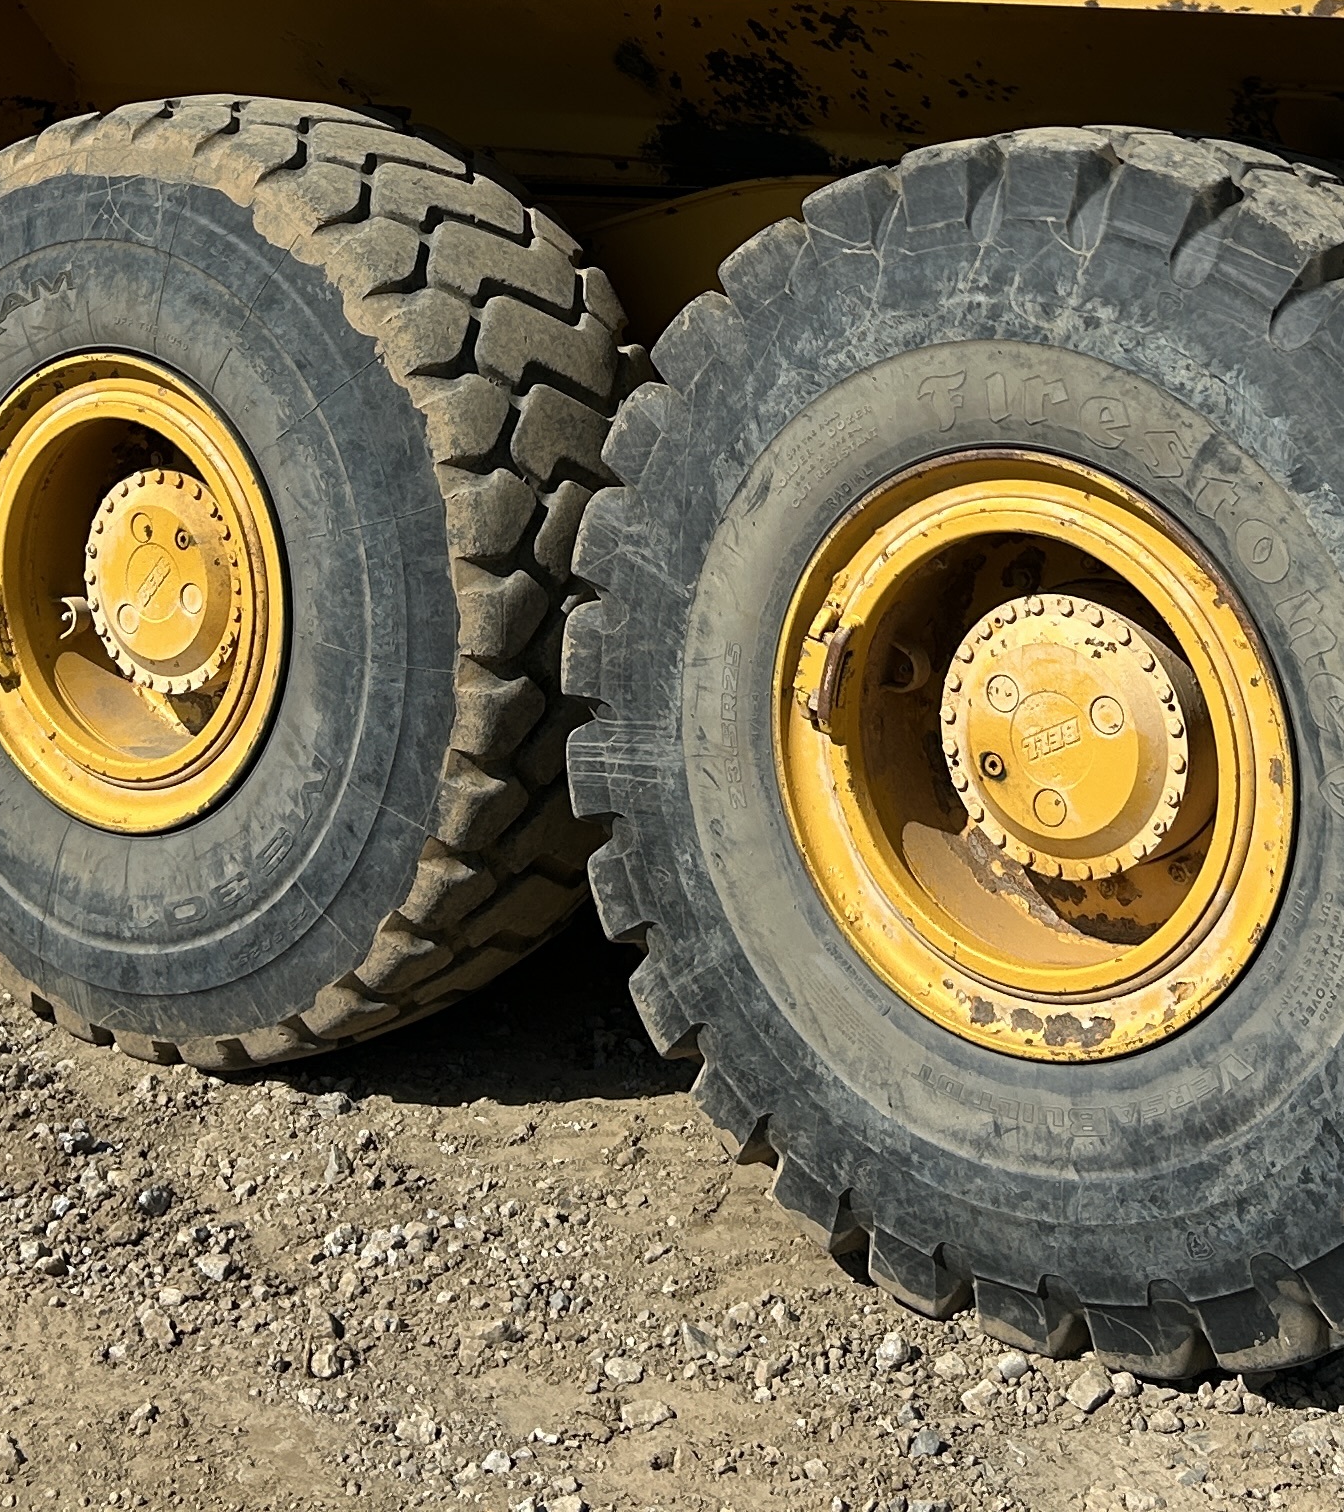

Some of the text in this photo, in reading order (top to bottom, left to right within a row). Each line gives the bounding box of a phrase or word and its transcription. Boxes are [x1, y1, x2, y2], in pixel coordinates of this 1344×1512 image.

[825, 463, 874, 509] RADIAL
[721, 640, 748, 809] 23.5R25
[1020, 715, 1081, 763] BELL
[1318, 891, 1334, 928] CUT
